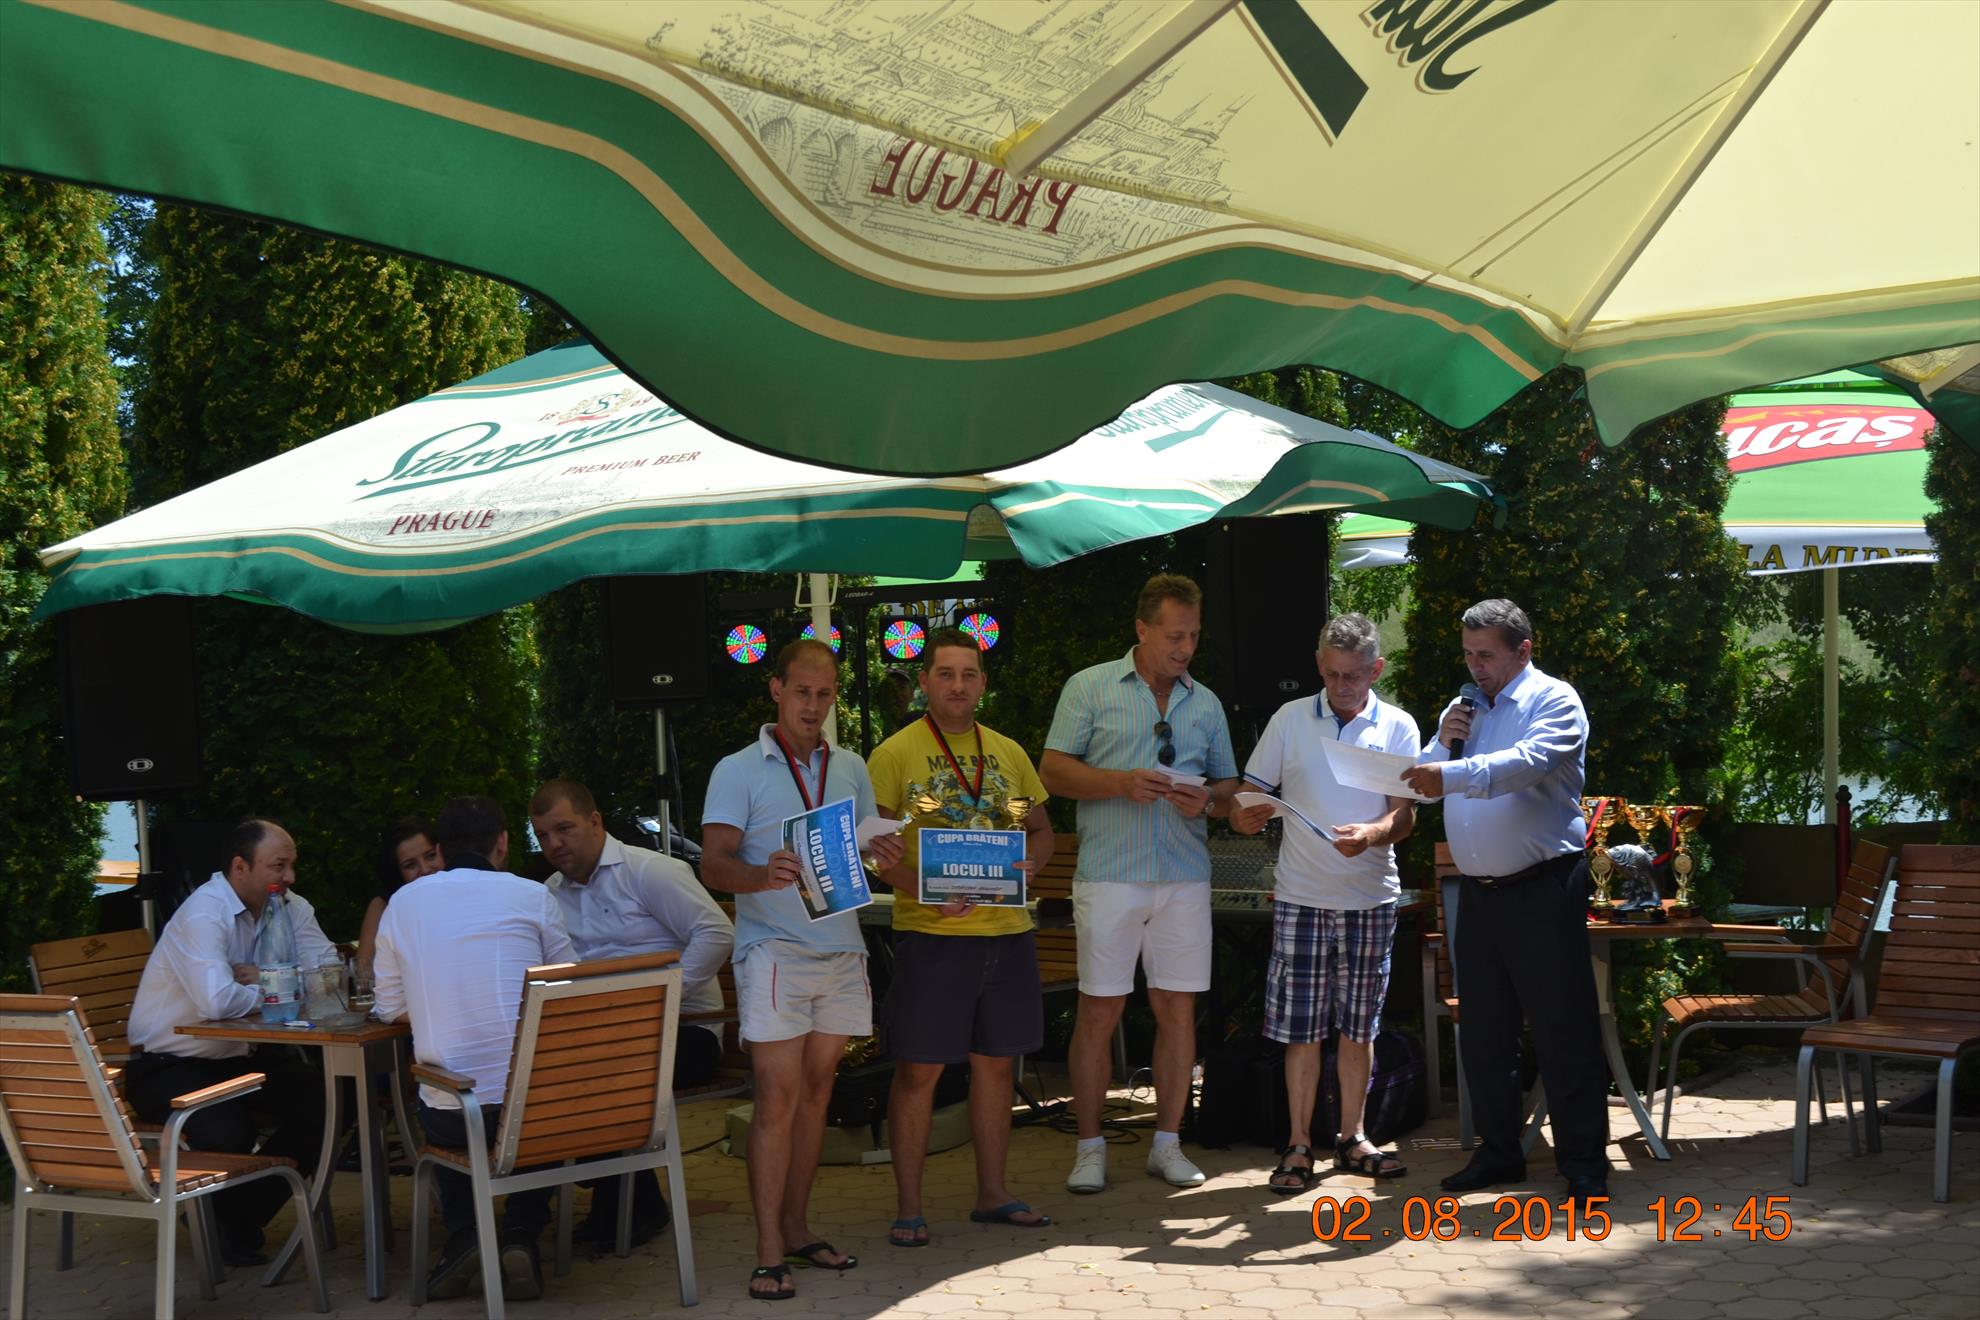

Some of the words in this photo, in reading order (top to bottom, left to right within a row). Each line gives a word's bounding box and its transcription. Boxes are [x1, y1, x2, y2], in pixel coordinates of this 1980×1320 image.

[560, 457, 649, 476] PREMIUM
[652, 450, 702, 467] BEER
[387, 507, 501, 537] PRAGUE
[840, 814, 852, 841] CUPA
[937, 833, 964, 845] CUPA
[809, 828, 828, 874] LOCUL
[942, 863, 986, 878] LOCUL
[988, 865, 1004, 878] III
[818, 875, 835, 893] III
